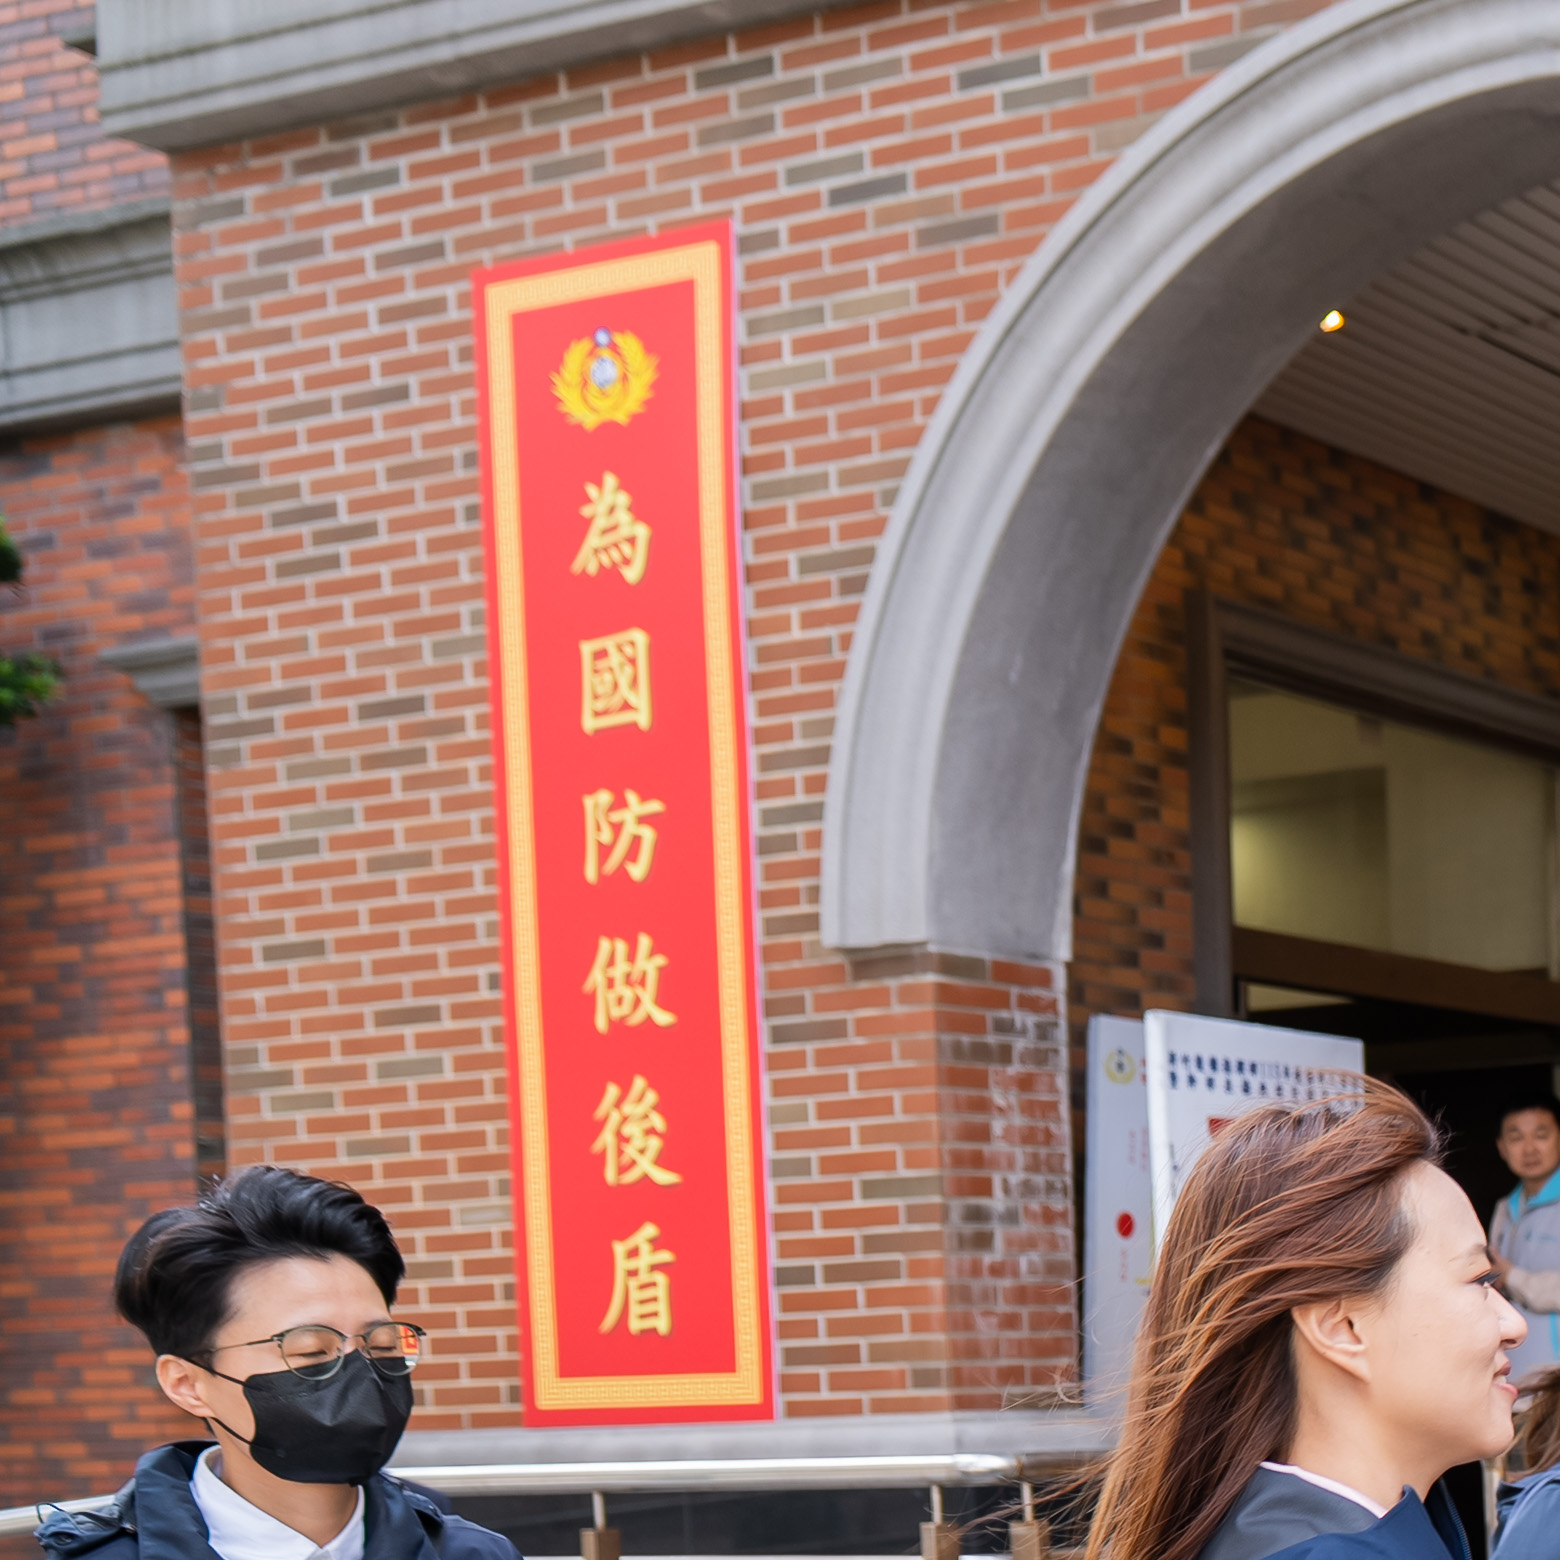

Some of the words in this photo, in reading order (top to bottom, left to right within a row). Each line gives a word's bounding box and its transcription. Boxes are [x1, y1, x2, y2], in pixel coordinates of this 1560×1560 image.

[570, 472, 683, 1336] 為國防做後盾
